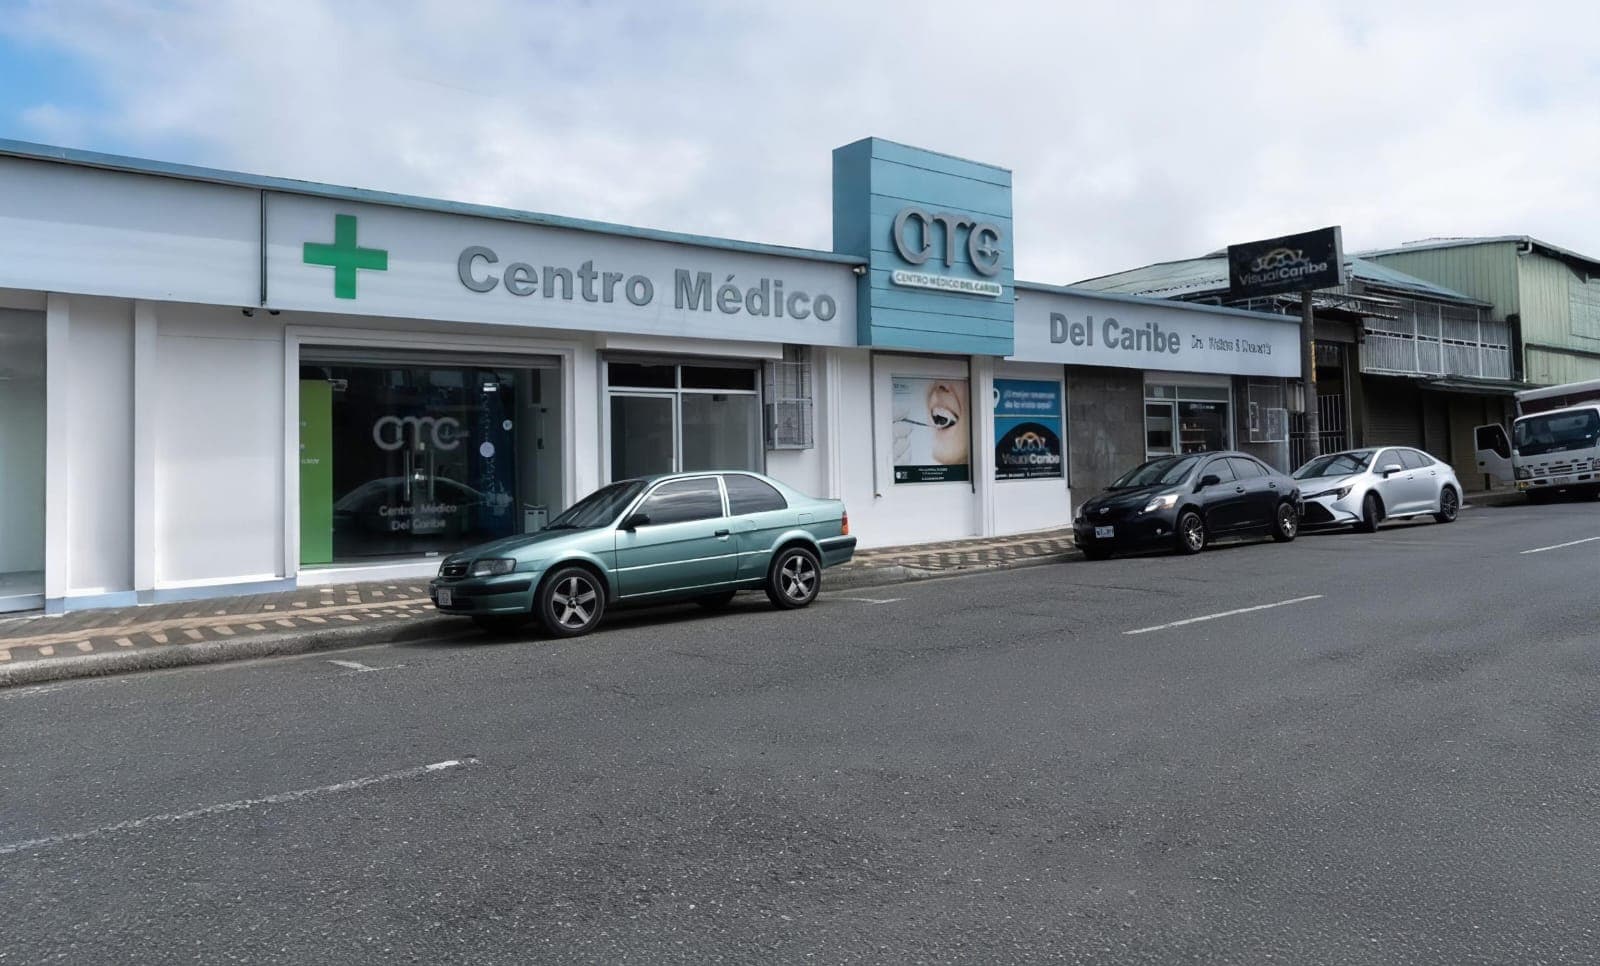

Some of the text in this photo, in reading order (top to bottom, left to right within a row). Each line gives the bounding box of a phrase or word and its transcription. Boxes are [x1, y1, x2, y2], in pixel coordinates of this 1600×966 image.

[457, 245, 837, 321] Centro Médico
[895, 271, 929, 285] CENTRO
[929, 275, 960, 289] MÉDICO
[960, 280, 974, 290] DEL
[1239, 262, 1328, 286] VisualCaribe
[1050, 312, 1093, 346] Del
[1102, 317, 1181, 354] Caribe
[379, 502, 457, 517] Centro Médico
[391, 518, 446, 530] Del Caribe
